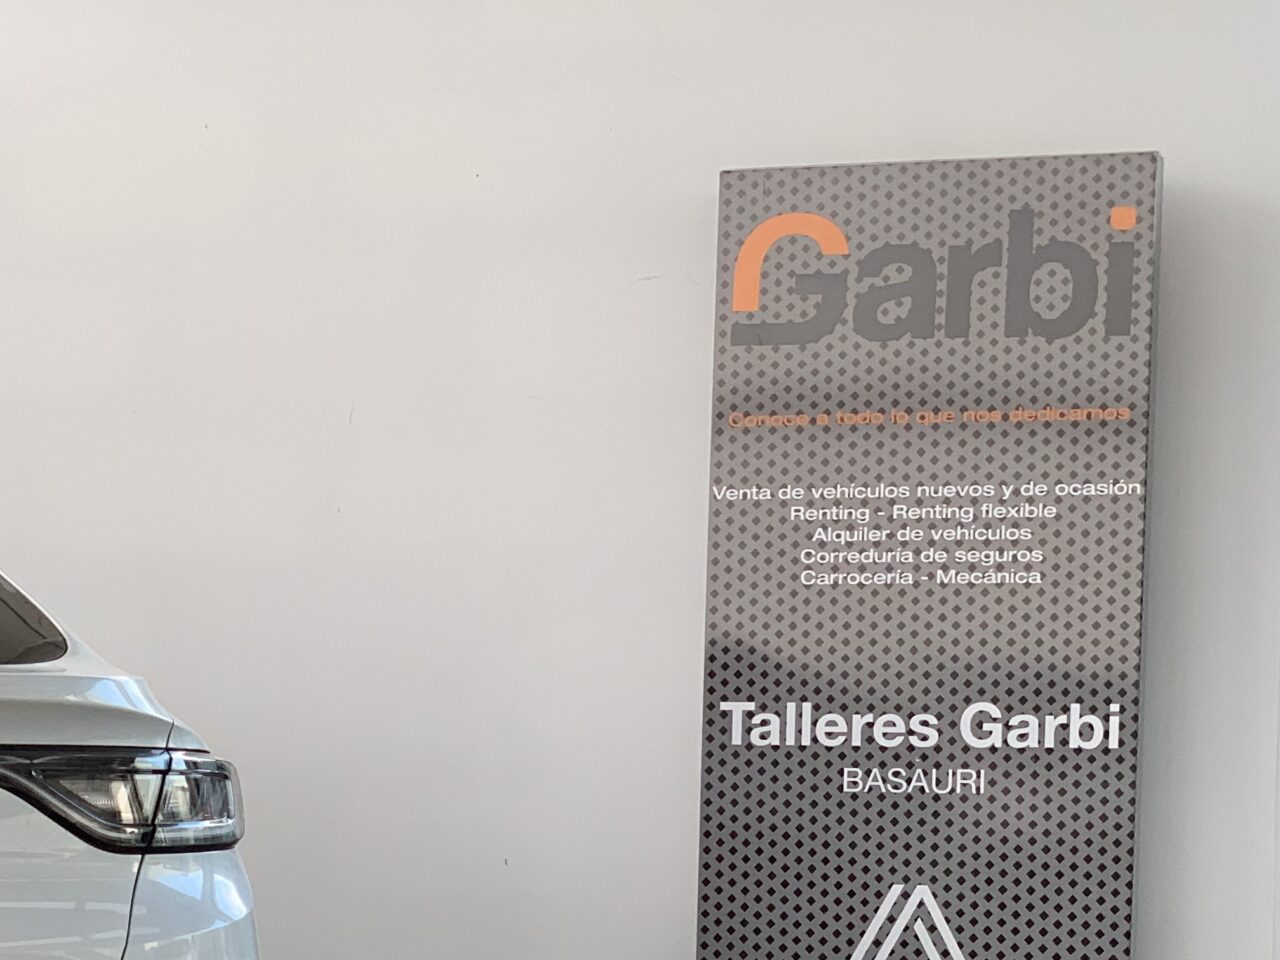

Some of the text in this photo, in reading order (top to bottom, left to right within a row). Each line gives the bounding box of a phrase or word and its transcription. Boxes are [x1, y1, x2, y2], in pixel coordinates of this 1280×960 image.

[730, 206, 1138, 347] Garbi
[729, 412, 809, 427] Conoce
[836, 411, 884, 425] todo
[891, 410, 909, 424] lo
[917, 410, 956, 426] que
[963, 409, 1002, 423] nos
[1009, 406, 1132, 421] dedicamos
[712, 479, 1141, 500] Venta de vehículos nuevos y de ocasión
[790, 506, 870, 523] Renting
[893, 504, 974, 522] Renting
[981, 503, 1057, 518] flexible
[812, 525, 1033, 545] Alquiler de vehículos
[800, 548, 1044, 566] Correduría de seguros
[800, 569, 914, 585] Carrocería
[936, 569, 1042, 584] Mecánica
[720, 701, 1121, 750] Talleres Garbi
[843, 767, 986, 795] BASAURI
